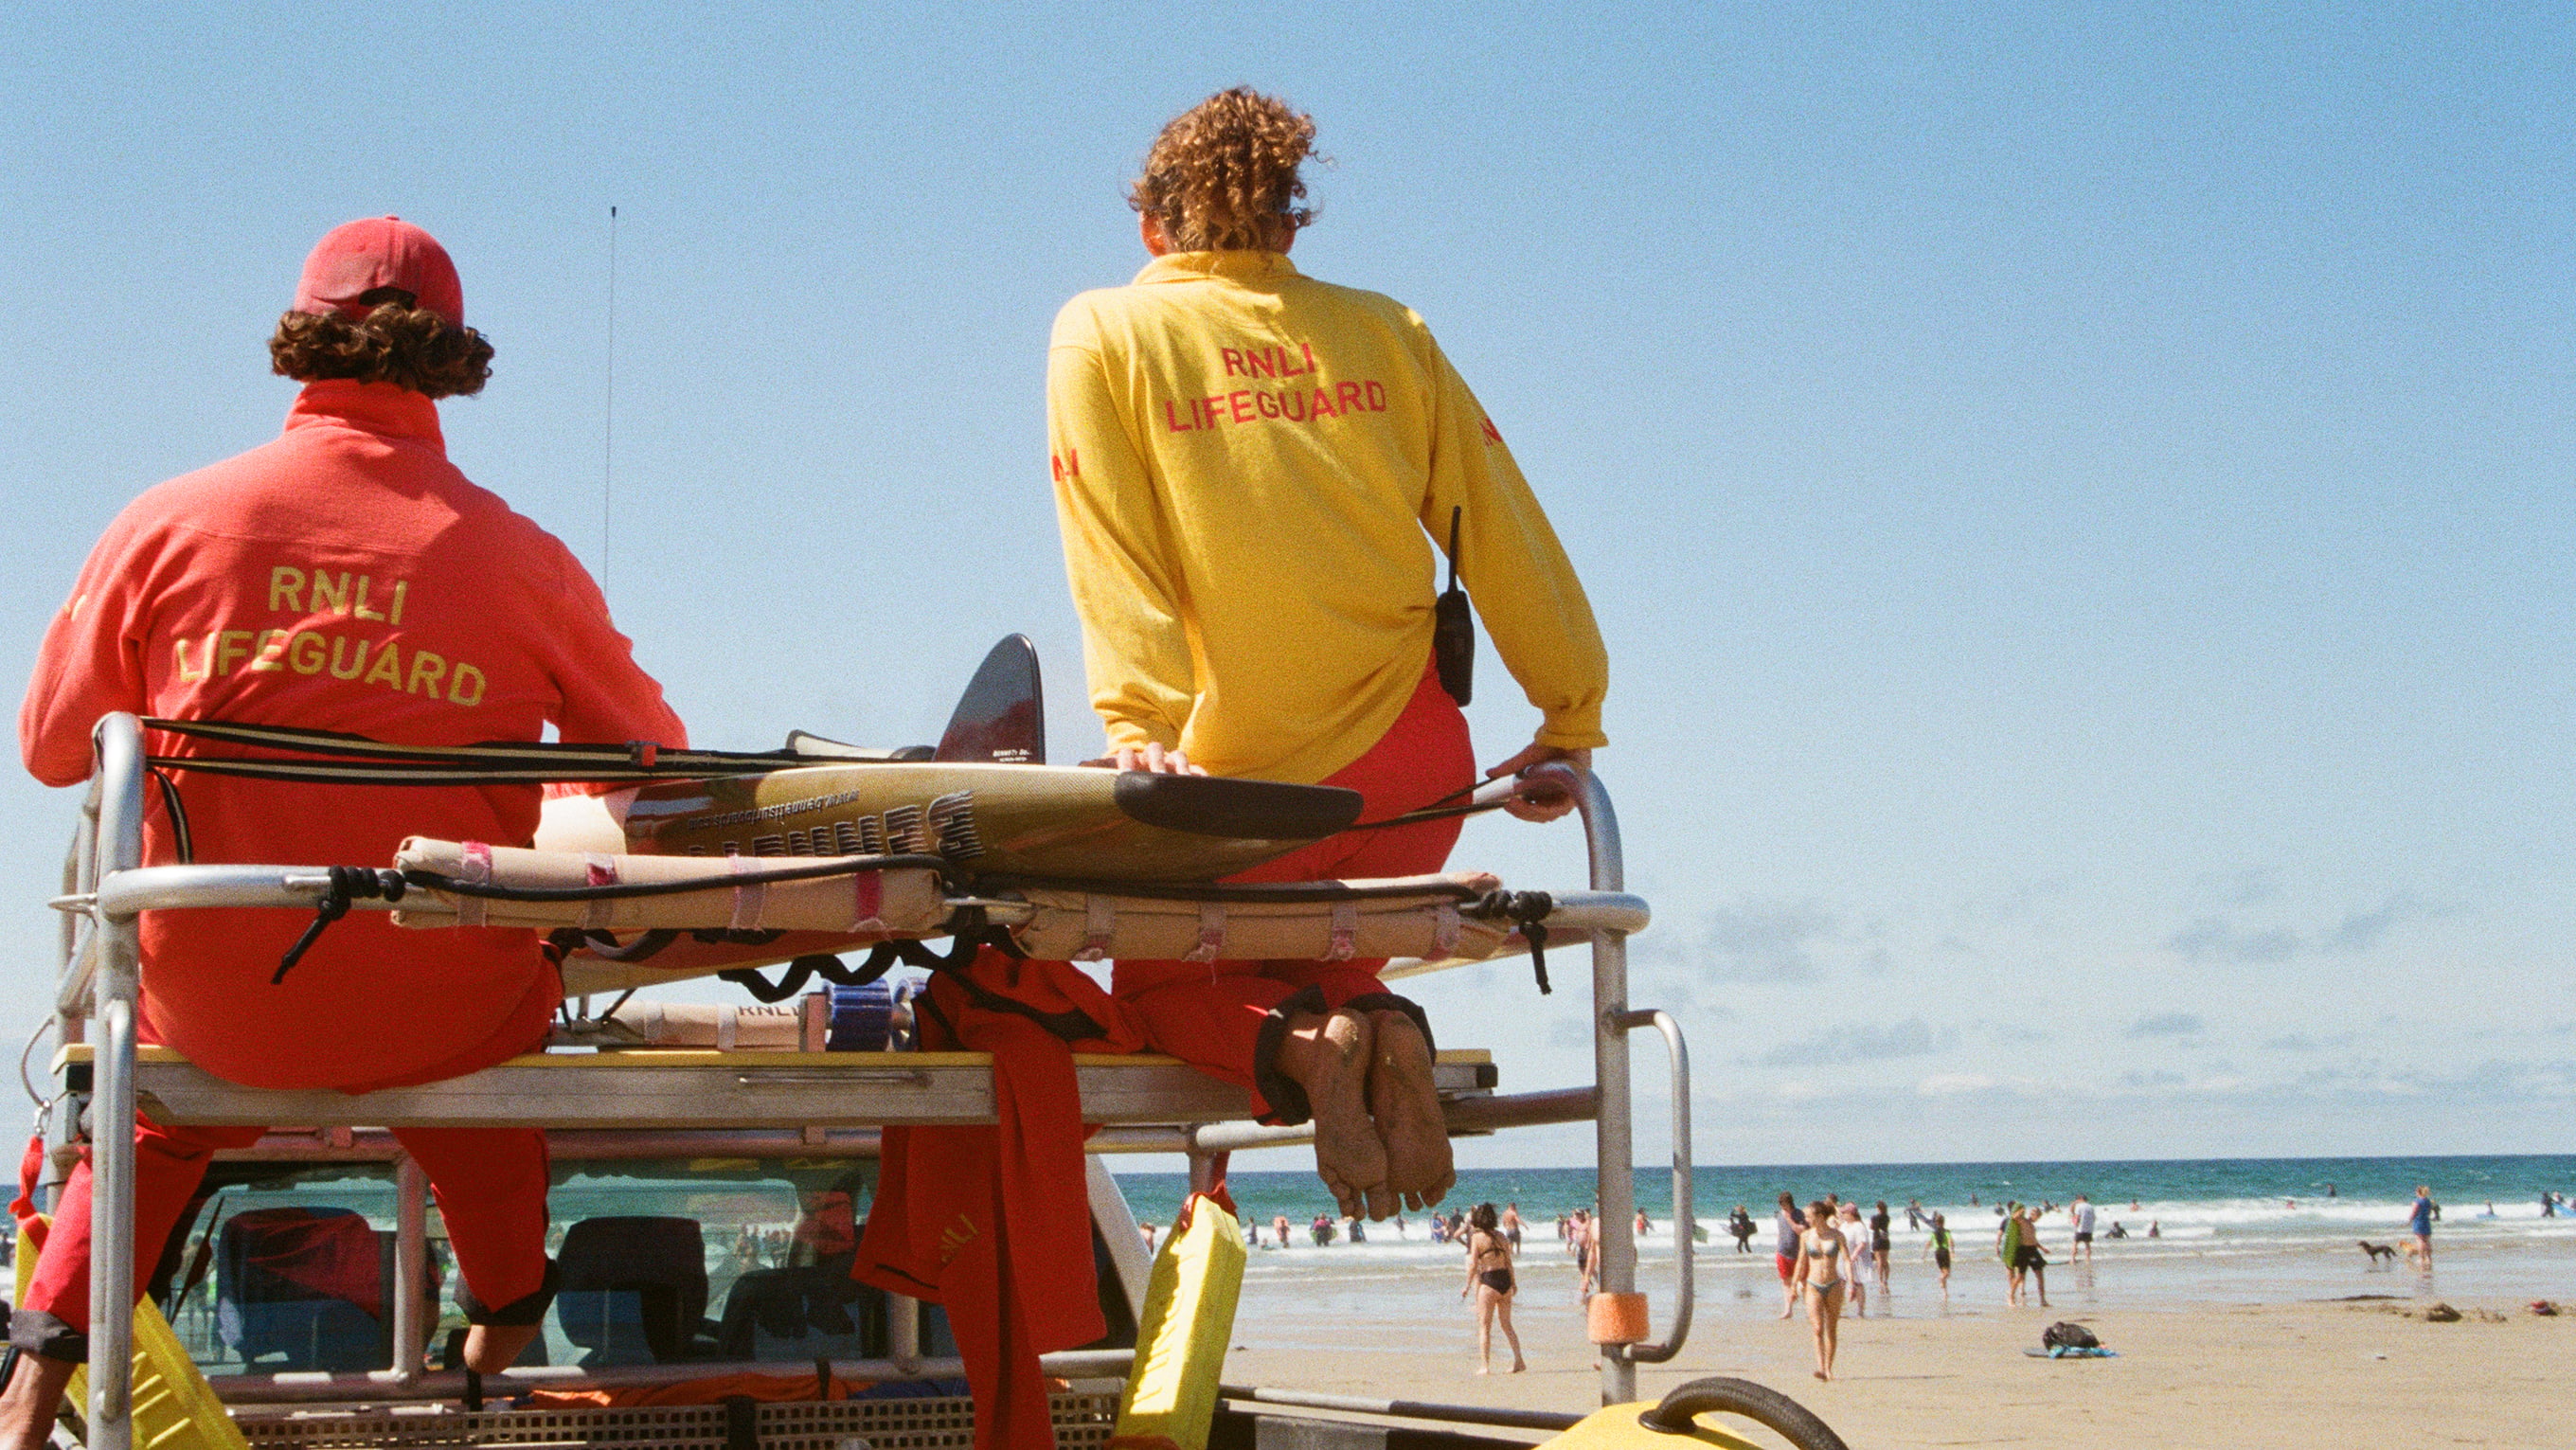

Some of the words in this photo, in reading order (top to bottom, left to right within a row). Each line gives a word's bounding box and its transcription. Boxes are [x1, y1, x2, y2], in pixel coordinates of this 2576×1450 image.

[1221, 342, 1316, 379] RNLI
[1164, 380, 1387, 433] LIFEGUARD
[268, 565, 408, 626] RNLI
[177, 629, 487, 707] LIFEGUARD
